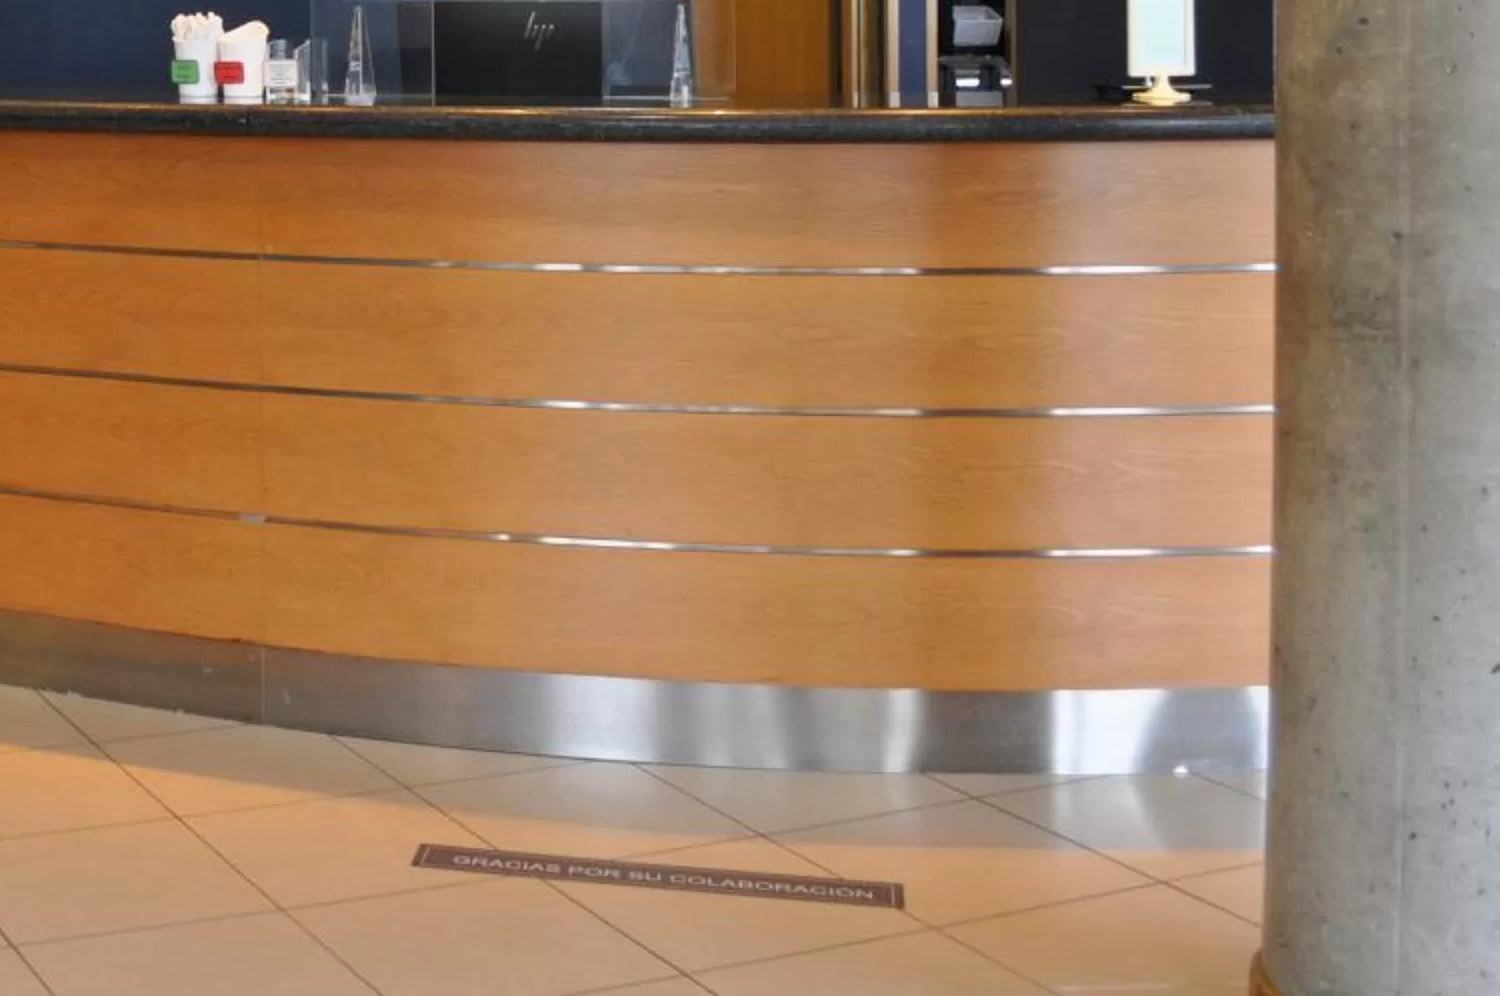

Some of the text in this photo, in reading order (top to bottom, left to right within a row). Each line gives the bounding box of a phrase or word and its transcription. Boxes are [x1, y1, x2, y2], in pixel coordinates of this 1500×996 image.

[523, 11, 555, 53] hp
[452, 854, 562, 874] GRACIAS
[567, 866, 621, 880] POR
[628, 871, 661, 882] SU
